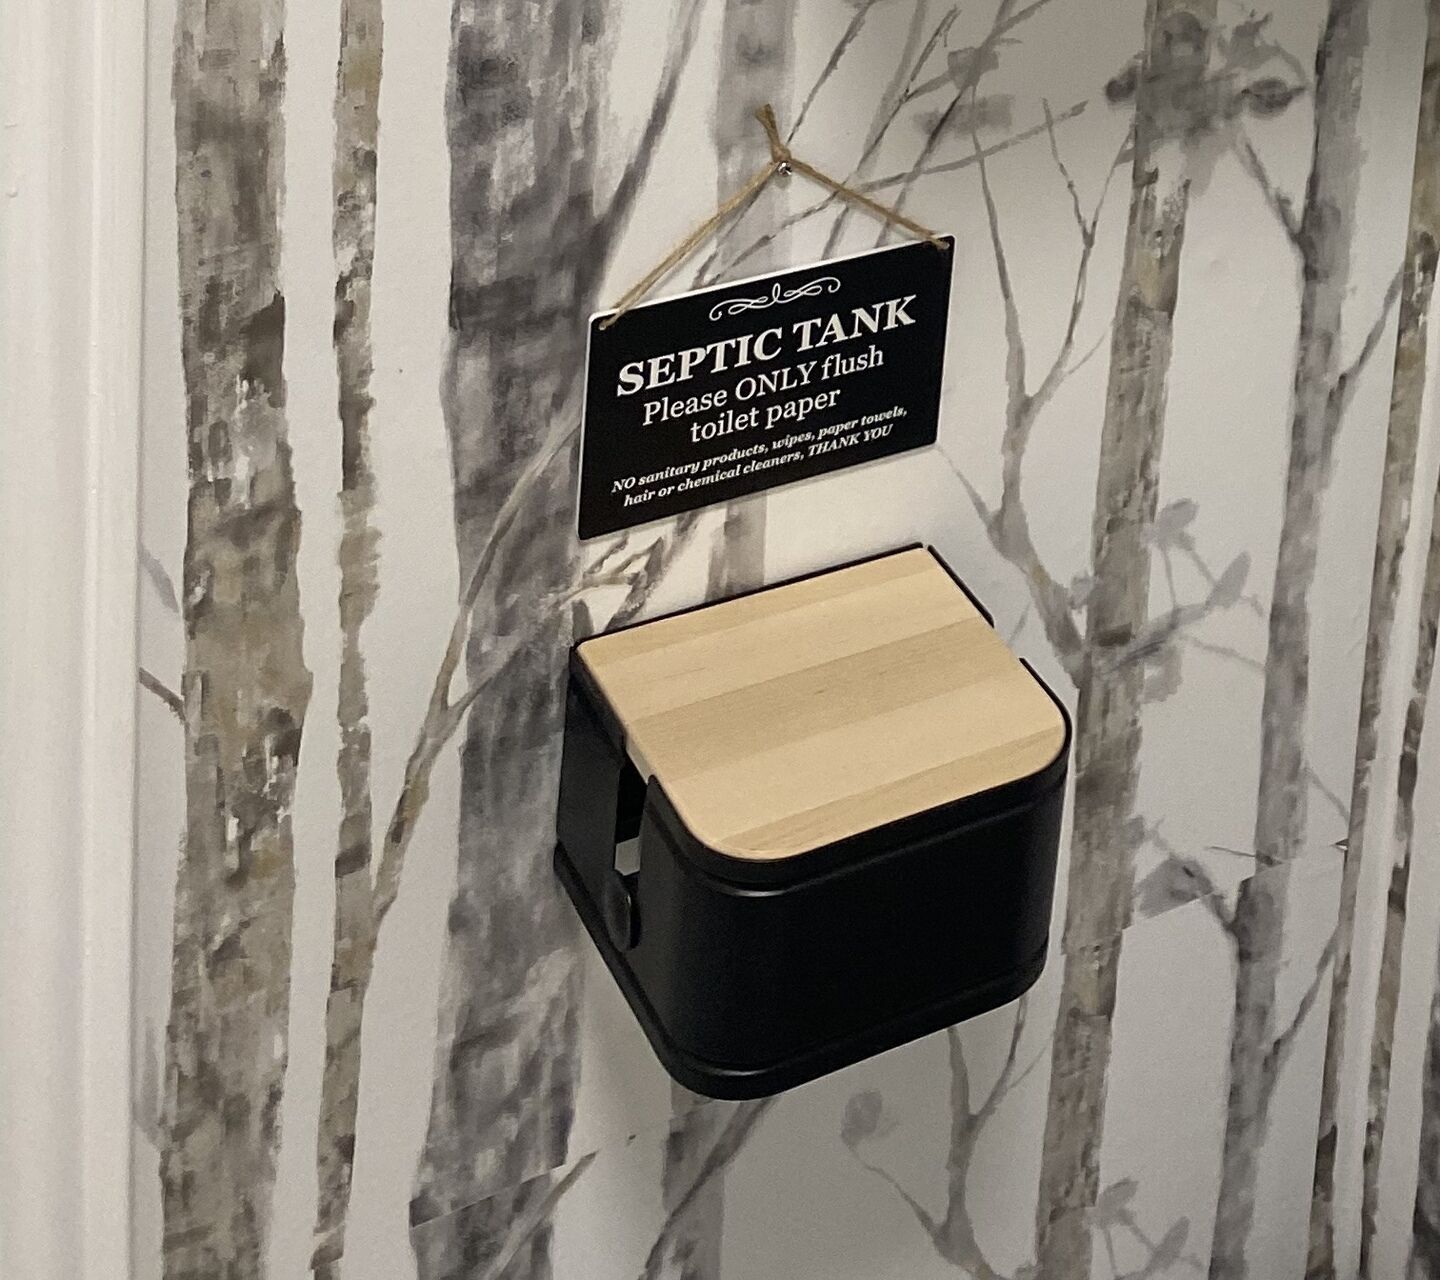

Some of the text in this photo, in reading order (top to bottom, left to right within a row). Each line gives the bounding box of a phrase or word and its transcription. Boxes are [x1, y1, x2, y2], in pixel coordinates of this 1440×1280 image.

[616, 295, 917, 397] SEPTIC TANK
[642, 345, 883, 427] Please ONLY flush
[611, 406, 908, 493] NO sanitary products, wipes, paper towels,
[690, 388, 841, 442] toilet paper
[623, 424, 893, 507] hair or chemical cleaners, THANK YOU
